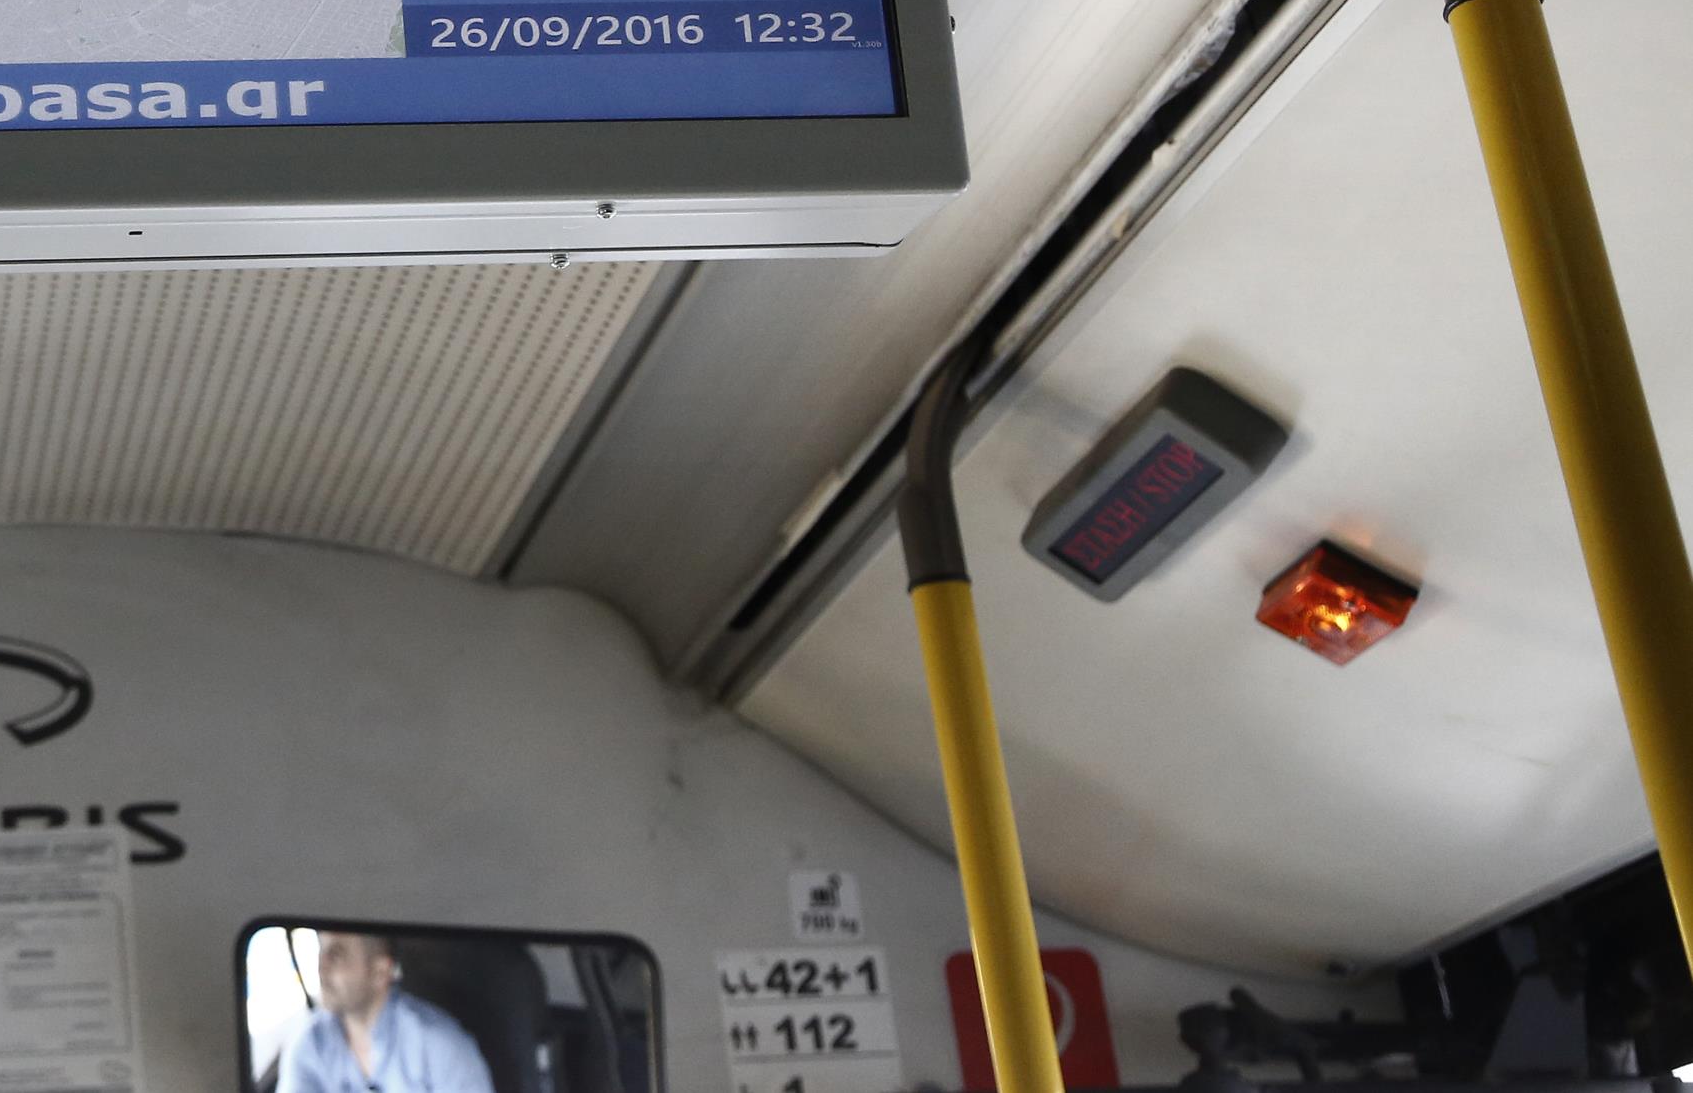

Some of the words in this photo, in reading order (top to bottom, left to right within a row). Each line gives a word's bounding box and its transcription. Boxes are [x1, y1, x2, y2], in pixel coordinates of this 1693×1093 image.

[430, 13, 704, 51] 26/09/2016
[735, 11, 857, 44] 12:32
[765, 956, 880, 997] 42+1
[774, 1013, 858, 1052] 112
